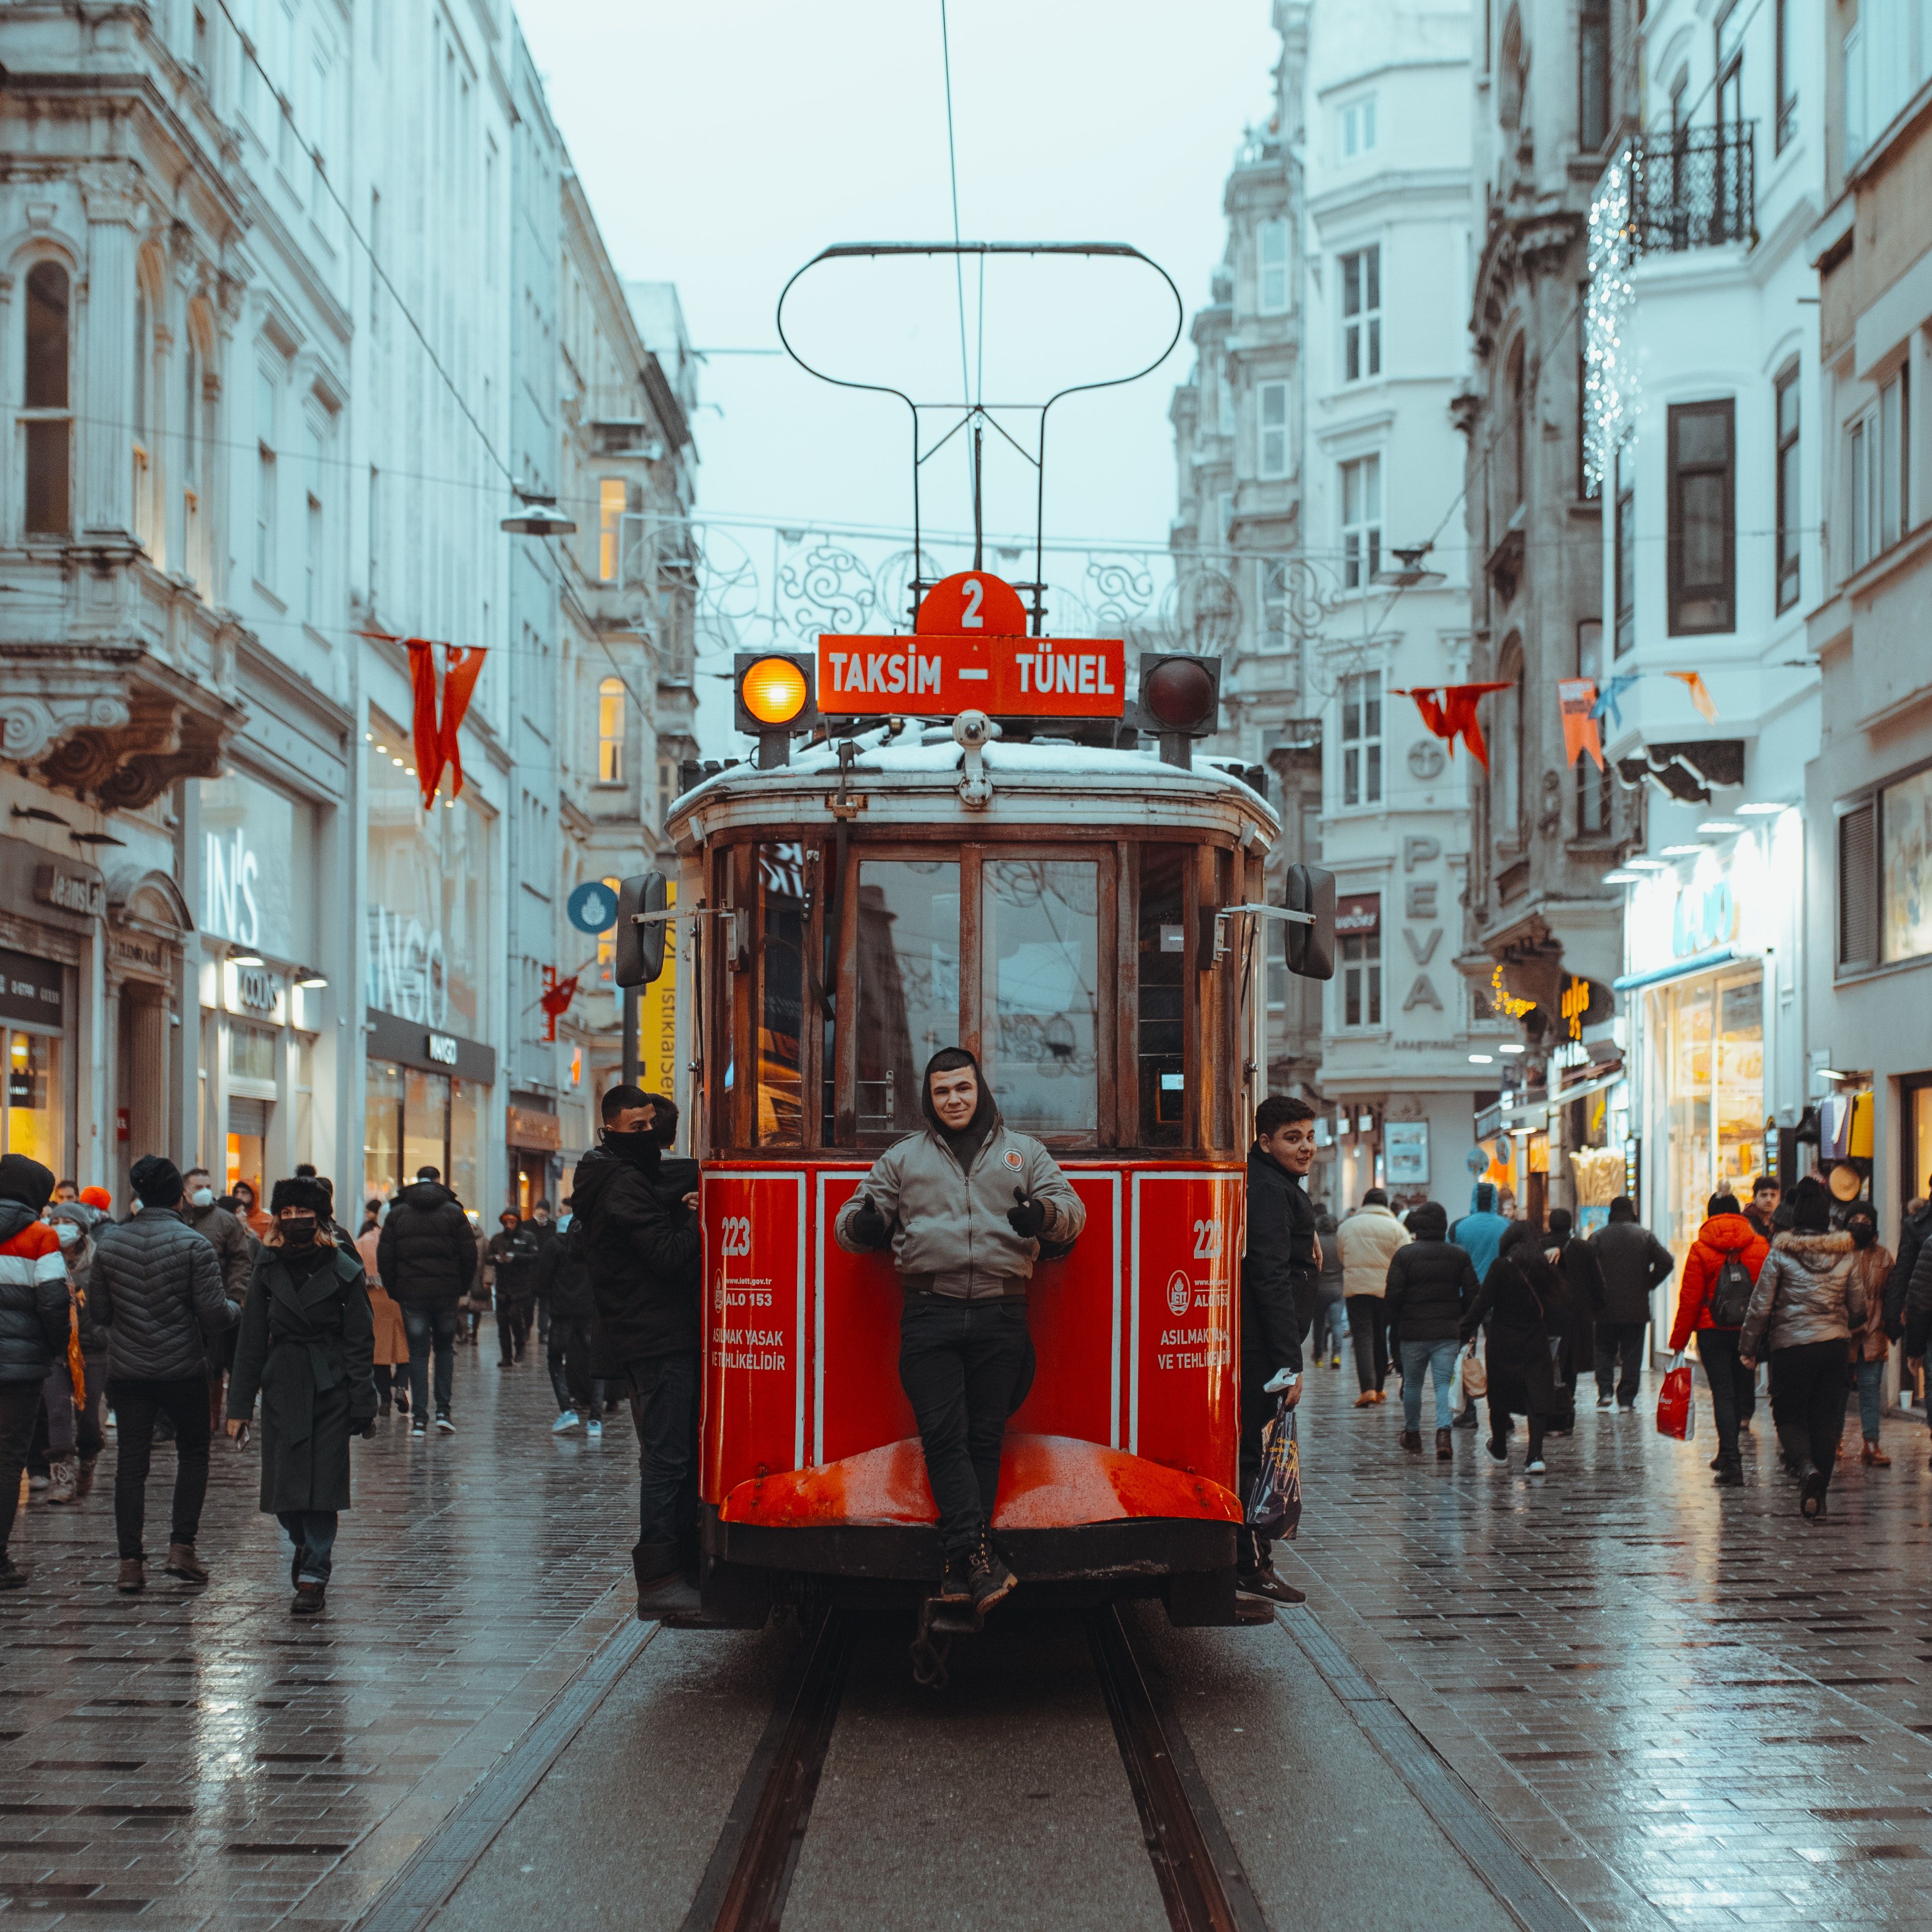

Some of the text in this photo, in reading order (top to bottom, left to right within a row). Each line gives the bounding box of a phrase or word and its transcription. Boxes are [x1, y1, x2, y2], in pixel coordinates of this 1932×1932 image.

[962, 579, 984, 628] 2
[829, 644, 942, 695] TAKSİM
[1016, 643, 1115, 695] TÜNEL
[721, 1216, 750, 1256] 223
[1194, 1219, 1222, 1259] 223
[725, 1277, 772, 1286] www.iett.gov.tr
[725, 1293, 772, 1306] ALO 153
[1194, 1295, 1214, 1307] ALO
[713, 1328, 783, 1346] ASILMAK YASAK
[1161, 1328, 1209, 1345] ASILMAK
[1158, 1354, 1173, 1369] VE
